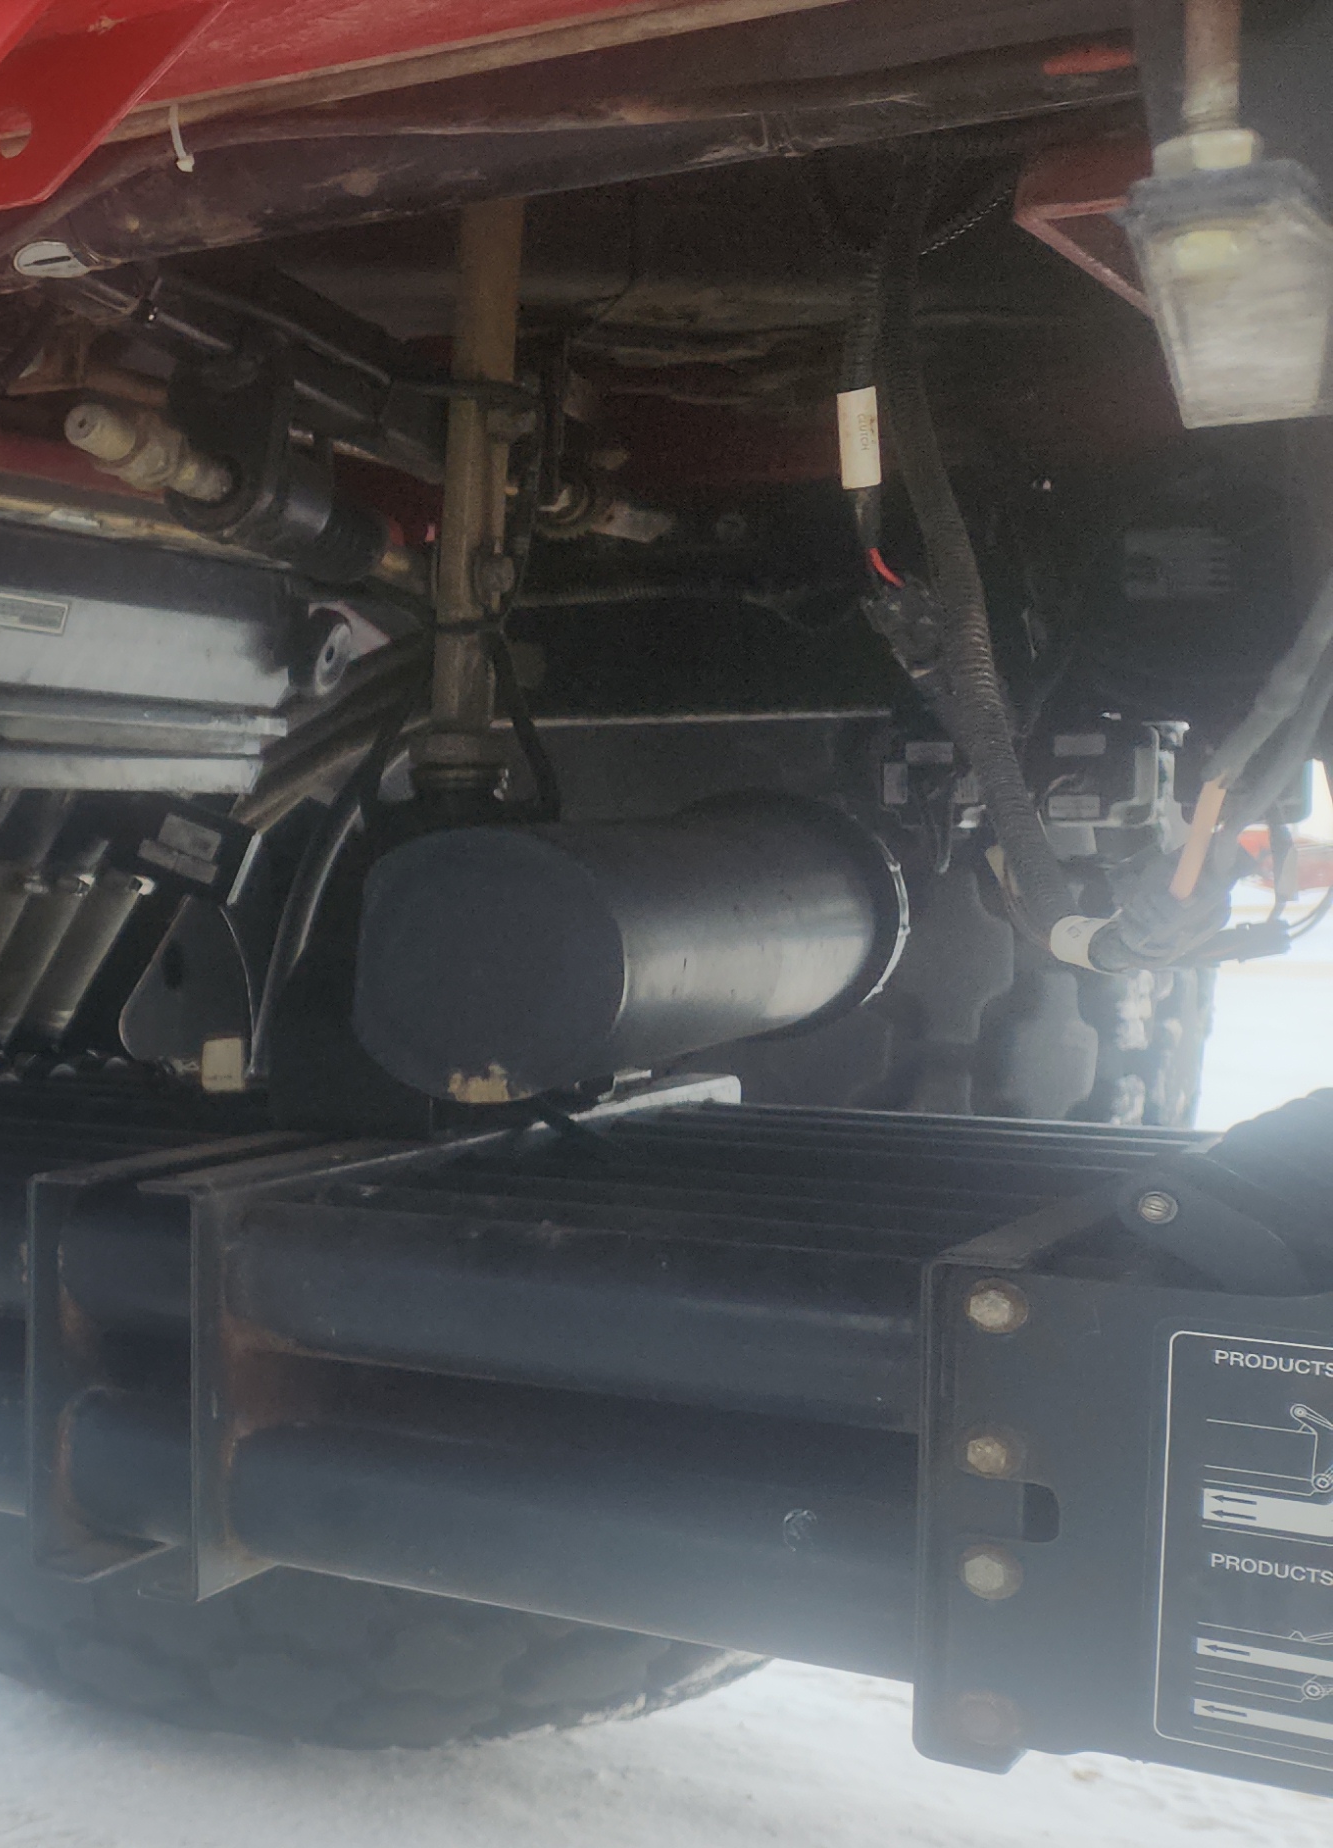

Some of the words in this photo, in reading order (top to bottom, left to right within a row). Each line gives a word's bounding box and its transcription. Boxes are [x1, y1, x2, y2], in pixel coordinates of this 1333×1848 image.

[856, 413, 870, 451] CLUTCH
[1214, 1349, 1333, 1378] PRODUCTS
[1210, 1553, 1333, 1586] PRODUCTS
